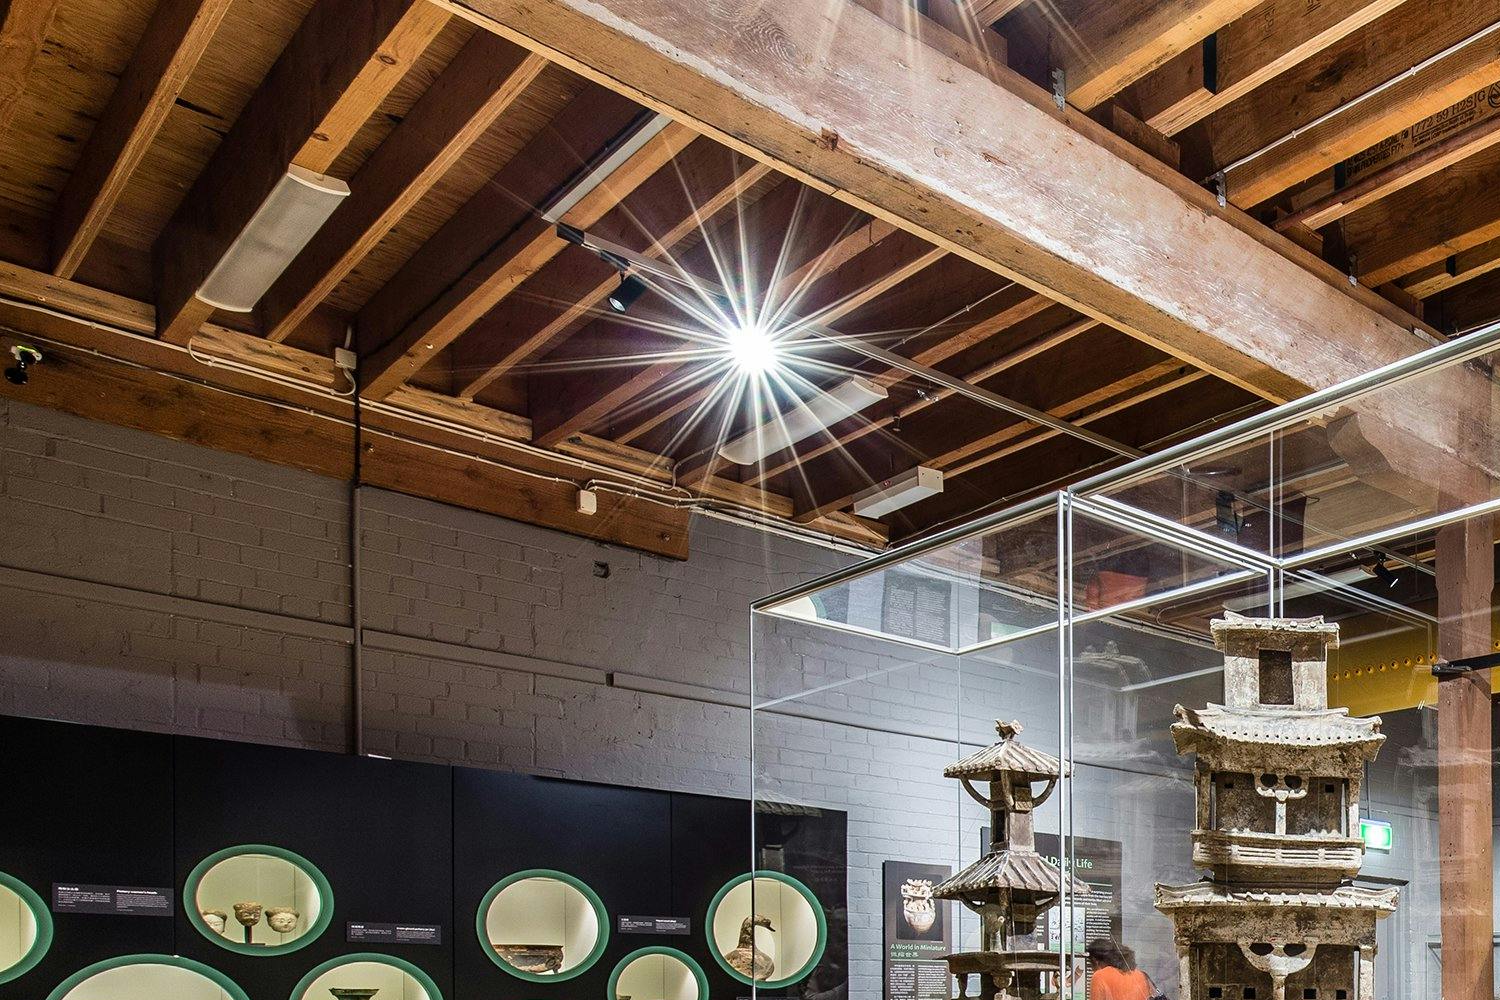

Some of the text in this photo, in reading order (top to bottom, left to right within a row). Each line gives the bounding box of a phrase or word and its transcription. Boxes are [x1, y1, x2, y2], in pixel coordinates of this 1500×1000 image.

[1416, 117, 1433, 133] 772
[1436, 109, 1449, 122] 59
[1478, 90, 1486, 102] G
[1076, 857, 1092, 869] Life
